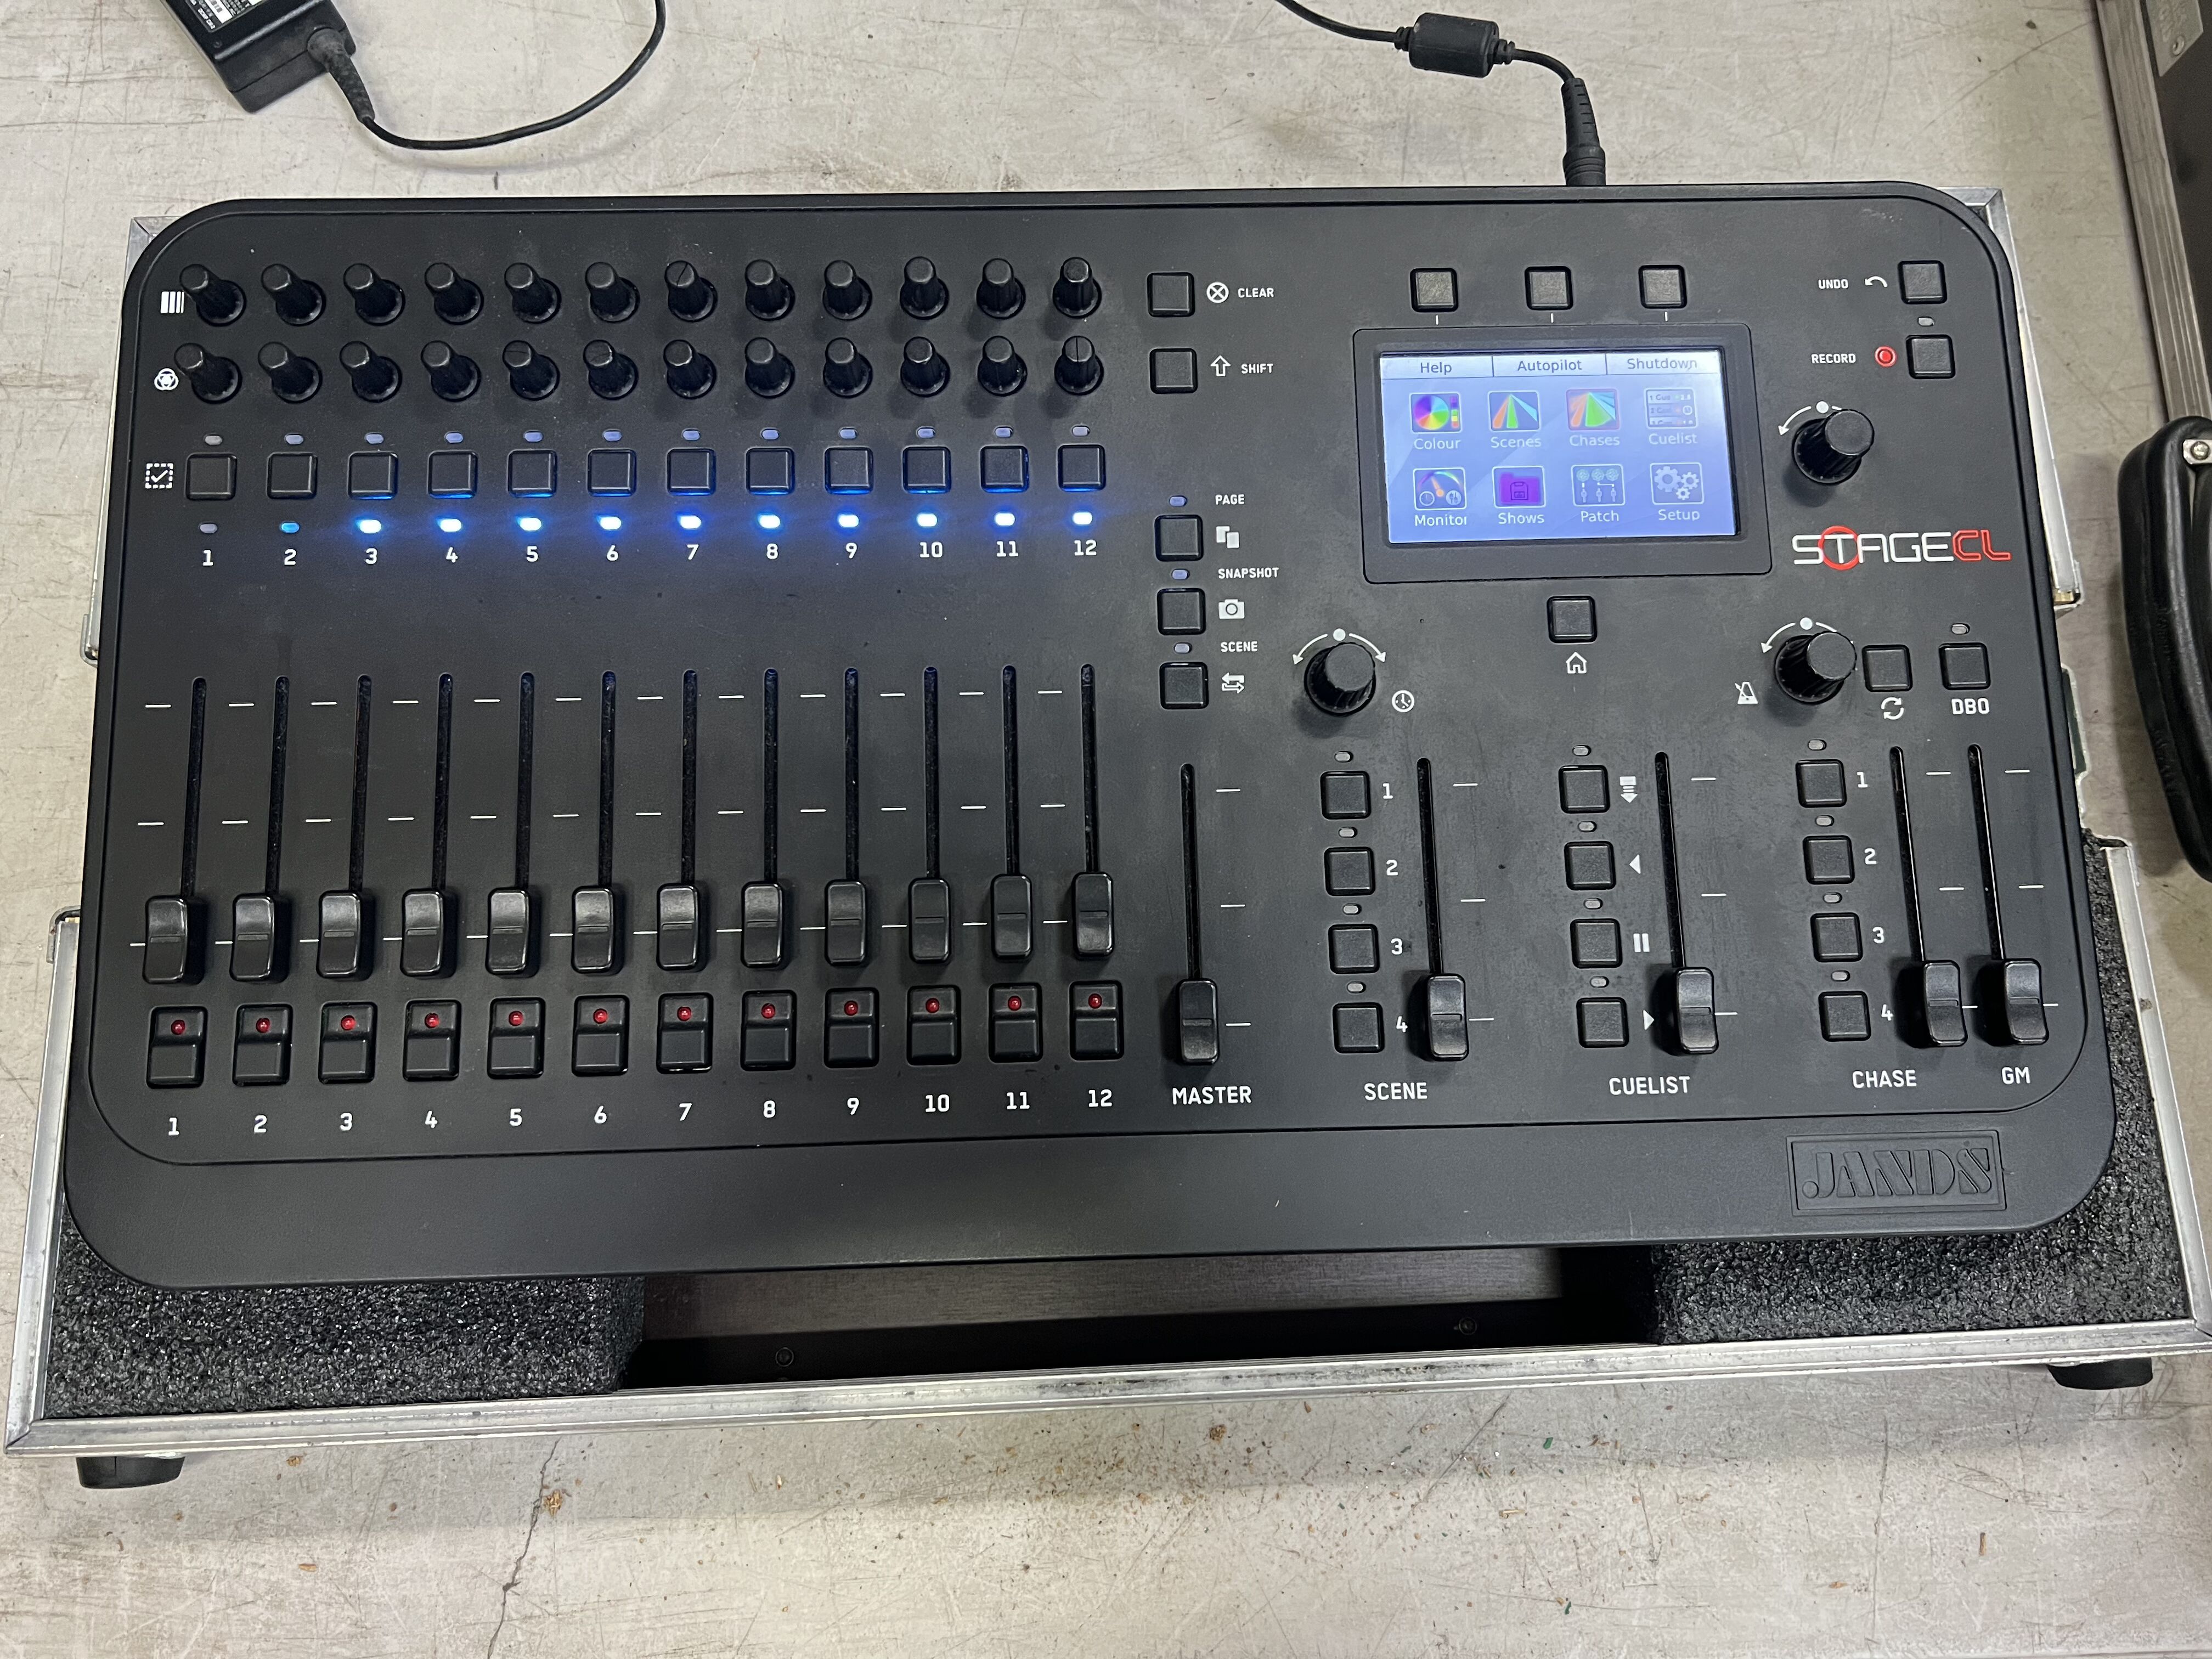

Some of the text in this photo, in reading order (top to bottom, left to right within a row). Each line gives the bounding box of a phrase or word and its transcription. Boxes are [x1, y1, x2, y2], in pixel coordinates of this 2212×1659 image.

[1238, 287, 1274, 298] CLEAR
[1818, 279, 1849, 289] UNDO
[1517, 359, 1583, 373] Autopilot
[1627, 357, 1697, 370] Shutdown
[1811, 353, 1856, 364] RECORD
[1241, 363, 1274, 374] SHIFT
[1419, 360, 1453, 376] Help
[1414, 438, 1461, 450] Colour
[1491, 436, 1542, 448] Scenes
[1569, 434, 1620, 447] Chases
[1649, 432, 1697, 445] Cuelist
[1215, 494, 1245, 505] PAGE
[1498, 512, 1544, 524] Shows
[1581, 510, 1619, 522] Patch
[1658, 509, 1700, 521] Setup
[445, 547, 458, 563] 4
[526, 546, 538, 562] 5
[606, 545, 618, 561] 6
[687, 544, 699, 560] 7
[766, 543, 778, 560] 8
[845, 542, 857, 558] 9
[919, 541, 943, 558] 10
[996, 540, 1019, 557] 11
[1074, 539, 1097, 556] 12
[202, 550, 213, 566] 1
[284, 549, 297, 565] 2
[365, 548, 377, 565] 3
[1218, 567, 1279, 579] SNAPSHOT
[1220, 641, 1258, 652] SCENE
[1951, 698, 1990, 715] DBO
[1857, 771, 1868, 788] 1
[1383, 783, 1393, 799] 1
[1864, 848, 1877, 865] 2
[1386, 859, 1398, 876] 2
[1872, 926, 1884, 944] 3
[1391, 938, 1403, 955] 3
[1881, 1004, 1893, 1021] 4
[1396, 1016, 1408, 1032] 4
[1852, 1069, 1917, 1088] CHASE
[2001, 1066, 2030, 1085] GM
[1364, 1082, 1427, 1101] SCENE
[1609, 1076, 1690, 1095] CUELIST
[925, 1094, 950, 1113] 10
[1006, 1092, 1030, 1110] 11
[1088, 1089, 1113, 1107] 12
[1172, 1086, 1251, 1105] MASTER
[594, 1105, 607, 1124] 6
[679, 1103, 692, 1121] 7
[763, 1100, 776, 1118] 8
[847, 1097, 859, 1115] 9
[253, 1115, 267, 1133] 2
[340, 1113, 353, 1131] 3
[425, 1110, 438, 1128] 4
[510, 1108, 522, 1126] 5
[168, 1117, 179, 1136] 1
[1802, 1148, 1991, 1198] JANDS
